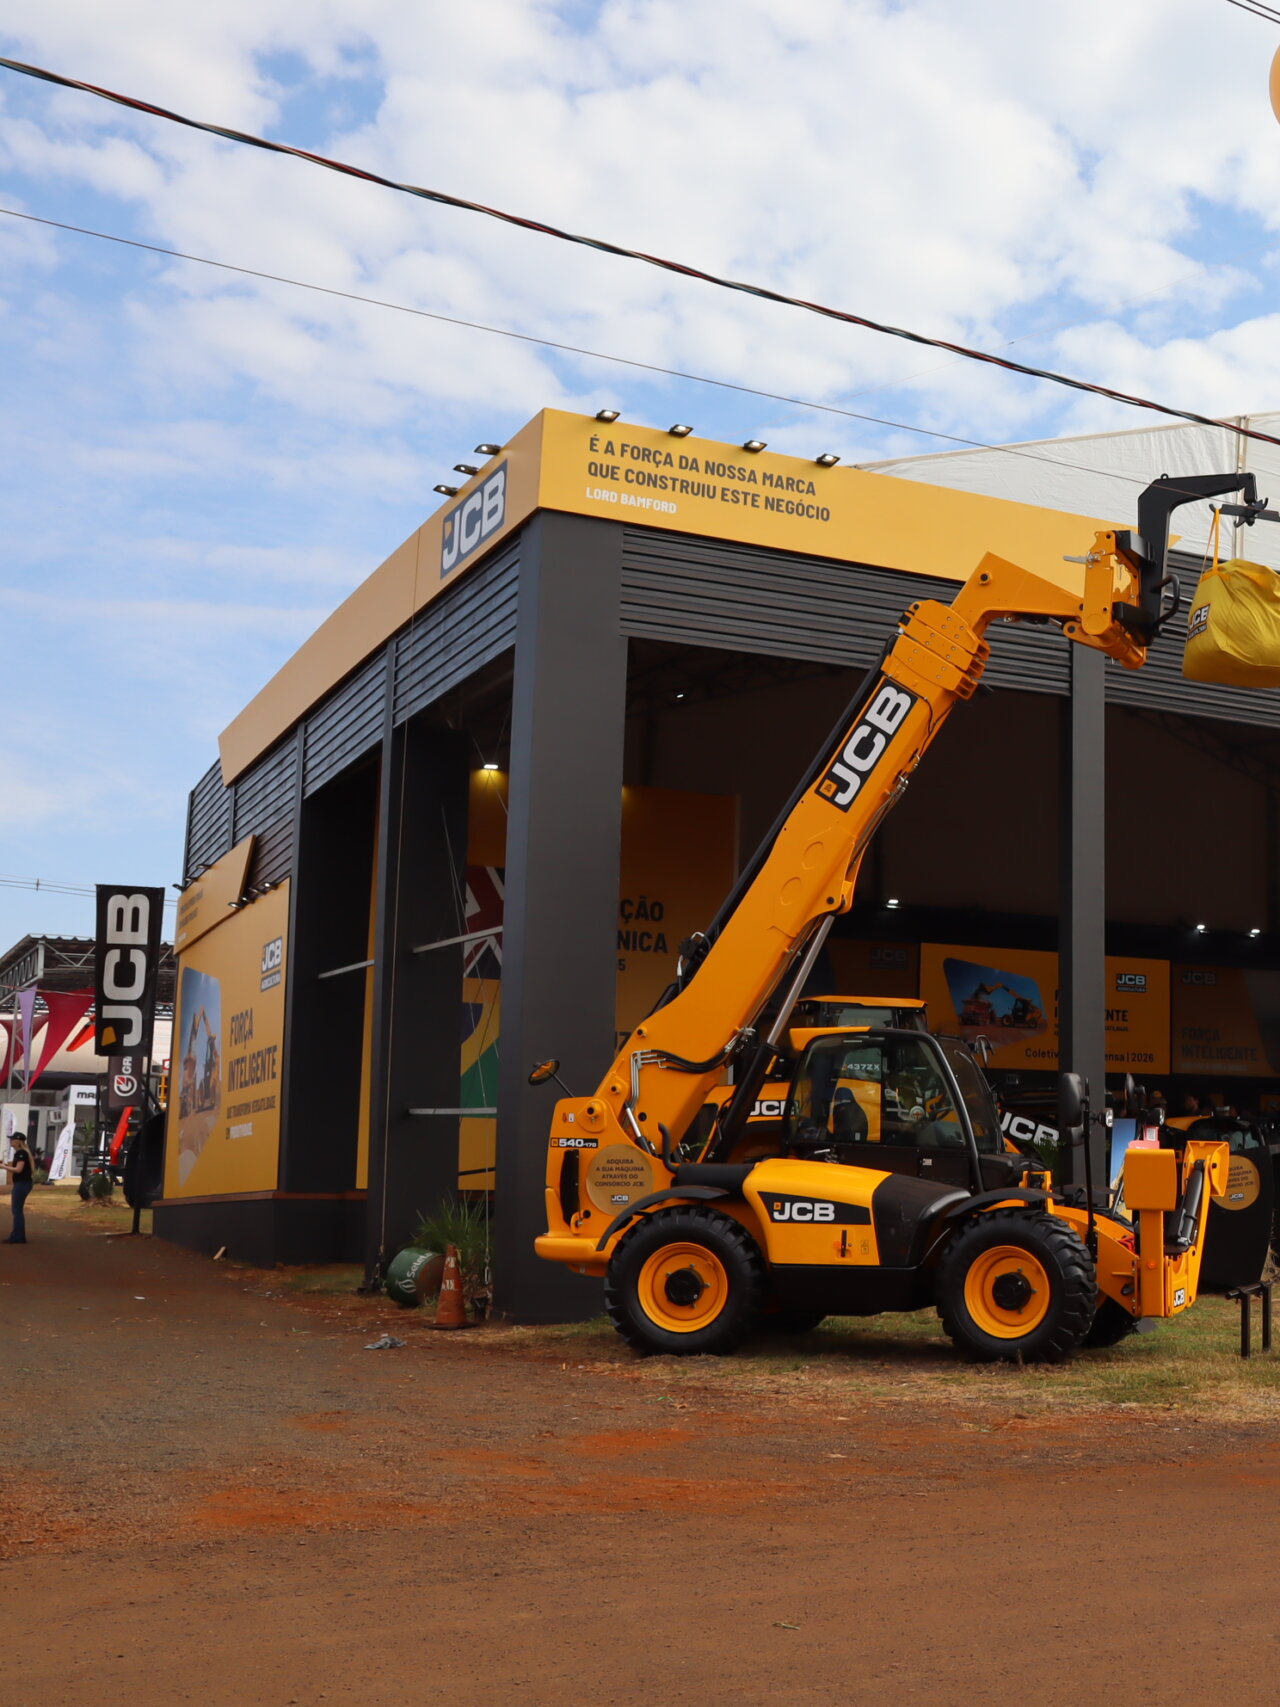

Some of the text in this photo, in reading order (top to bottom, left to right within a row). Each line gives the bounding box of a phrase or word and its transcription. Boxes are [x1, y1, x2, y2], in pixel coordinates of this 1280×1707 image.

[589, 434, 816, 496] É A FORÇA DA NOSSA MARCA
[586, 486, 677, 514] LORD BAMFORD
[587, 461, 830, 522] QUE CONSTRUIU ESTE NEGÓCIO
[442, 470, 505, 570] JCB
[1190, 606, 1209, 630] JCB
[831, 685, 912, 806] JCB
[102, 893, 150, 1047] JCB
[262, 938, 282, 972] JCB
[1117, 974, 1145, 985] JCB
[230, 1008, 254, 1049] FORÇA
[228, 1045, 278, 1092] INTELIGENTE
[847, 1063, 880, 1071] 437ZX
[1025, 1048, 1059, 1059] Coletiv
[1131, 1053, 1154, 1063] 2026
[999, 1111, 1060, 1147] JCB
[773, 1202, 835, 1222] JCB
[1174, 1288, 1185, 1308] JCB
